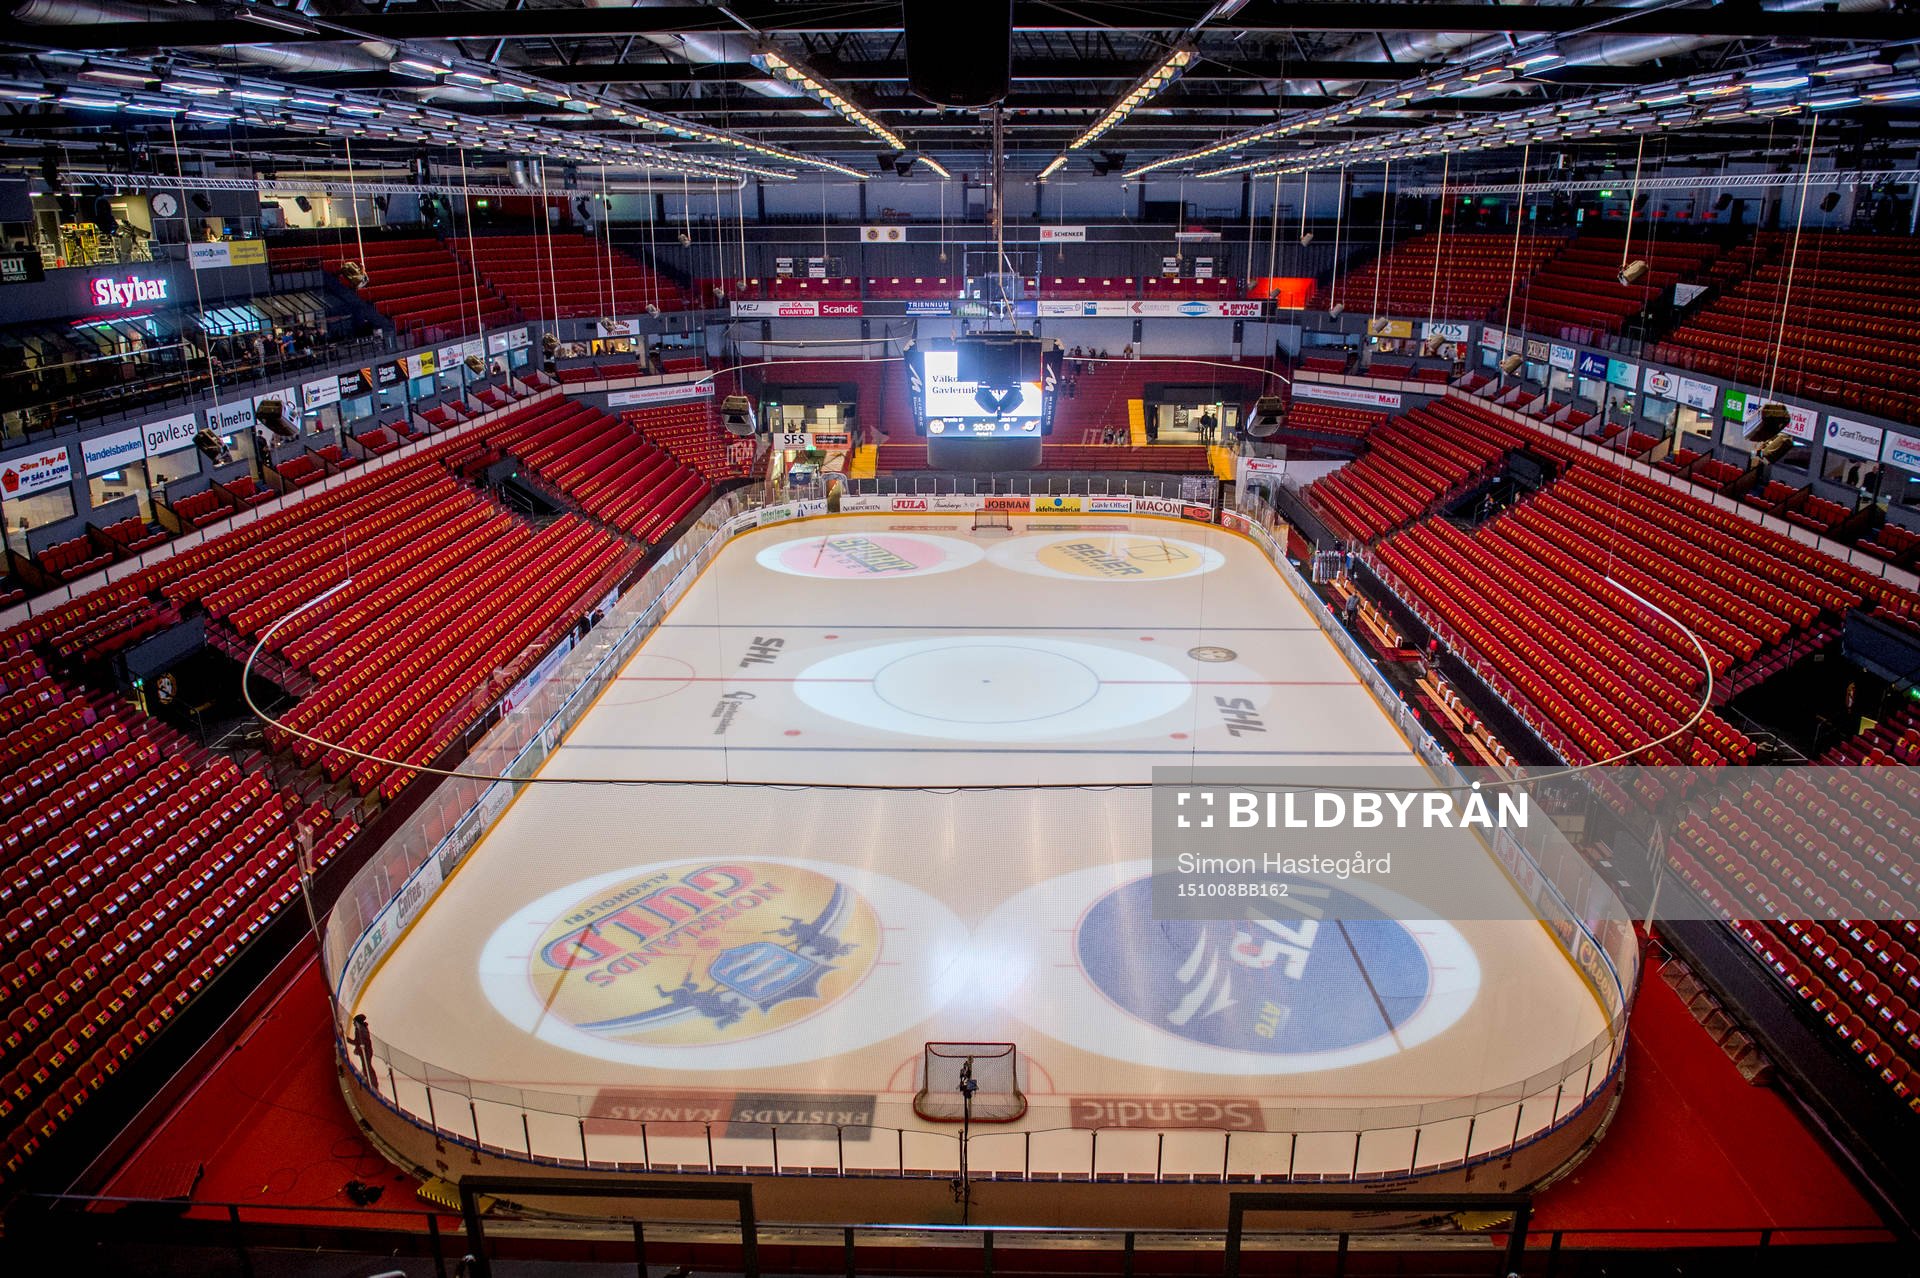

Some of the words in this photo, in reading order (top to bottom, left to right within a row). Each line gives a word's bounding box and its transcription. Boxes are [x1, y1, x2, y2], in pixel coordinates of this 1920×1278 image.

[93, 276, 167, 308] Skybar
[823, 305, 858, 314] Scandic
[1727, 399, 1742, 411] SEB
[210, 411, 251, 430] Blmetro
[973, 423, 995, 431] 20:00
[784, 435, 805, 445] SFS
[57, 452, 66, 461] AB
[85, 440, 142, 463] Handelsbanken
[894, 500, 926, 509] JULA
[985, 501, 1030, 509] JOBMAN
[1135, 500, 1181, 513] MACON
[739, 636, 785, 669] SHL
[1214, 695, 1267, 738] SHL
[563, 873, 670, 925] ALKOHOLFRI
[541, 865, 755, 971] GULD
[585, 881, 784, 989] NORRLANDS
[350, 928, 382, 983] PEAB
[1255, 1001, 1286, 1039] ATG
[609, 1105, 722, 1122] KANSAS
[739, 1107, 875, 1126] FRISTADS
[1081, 1101, 1255, 1128] Scandic
